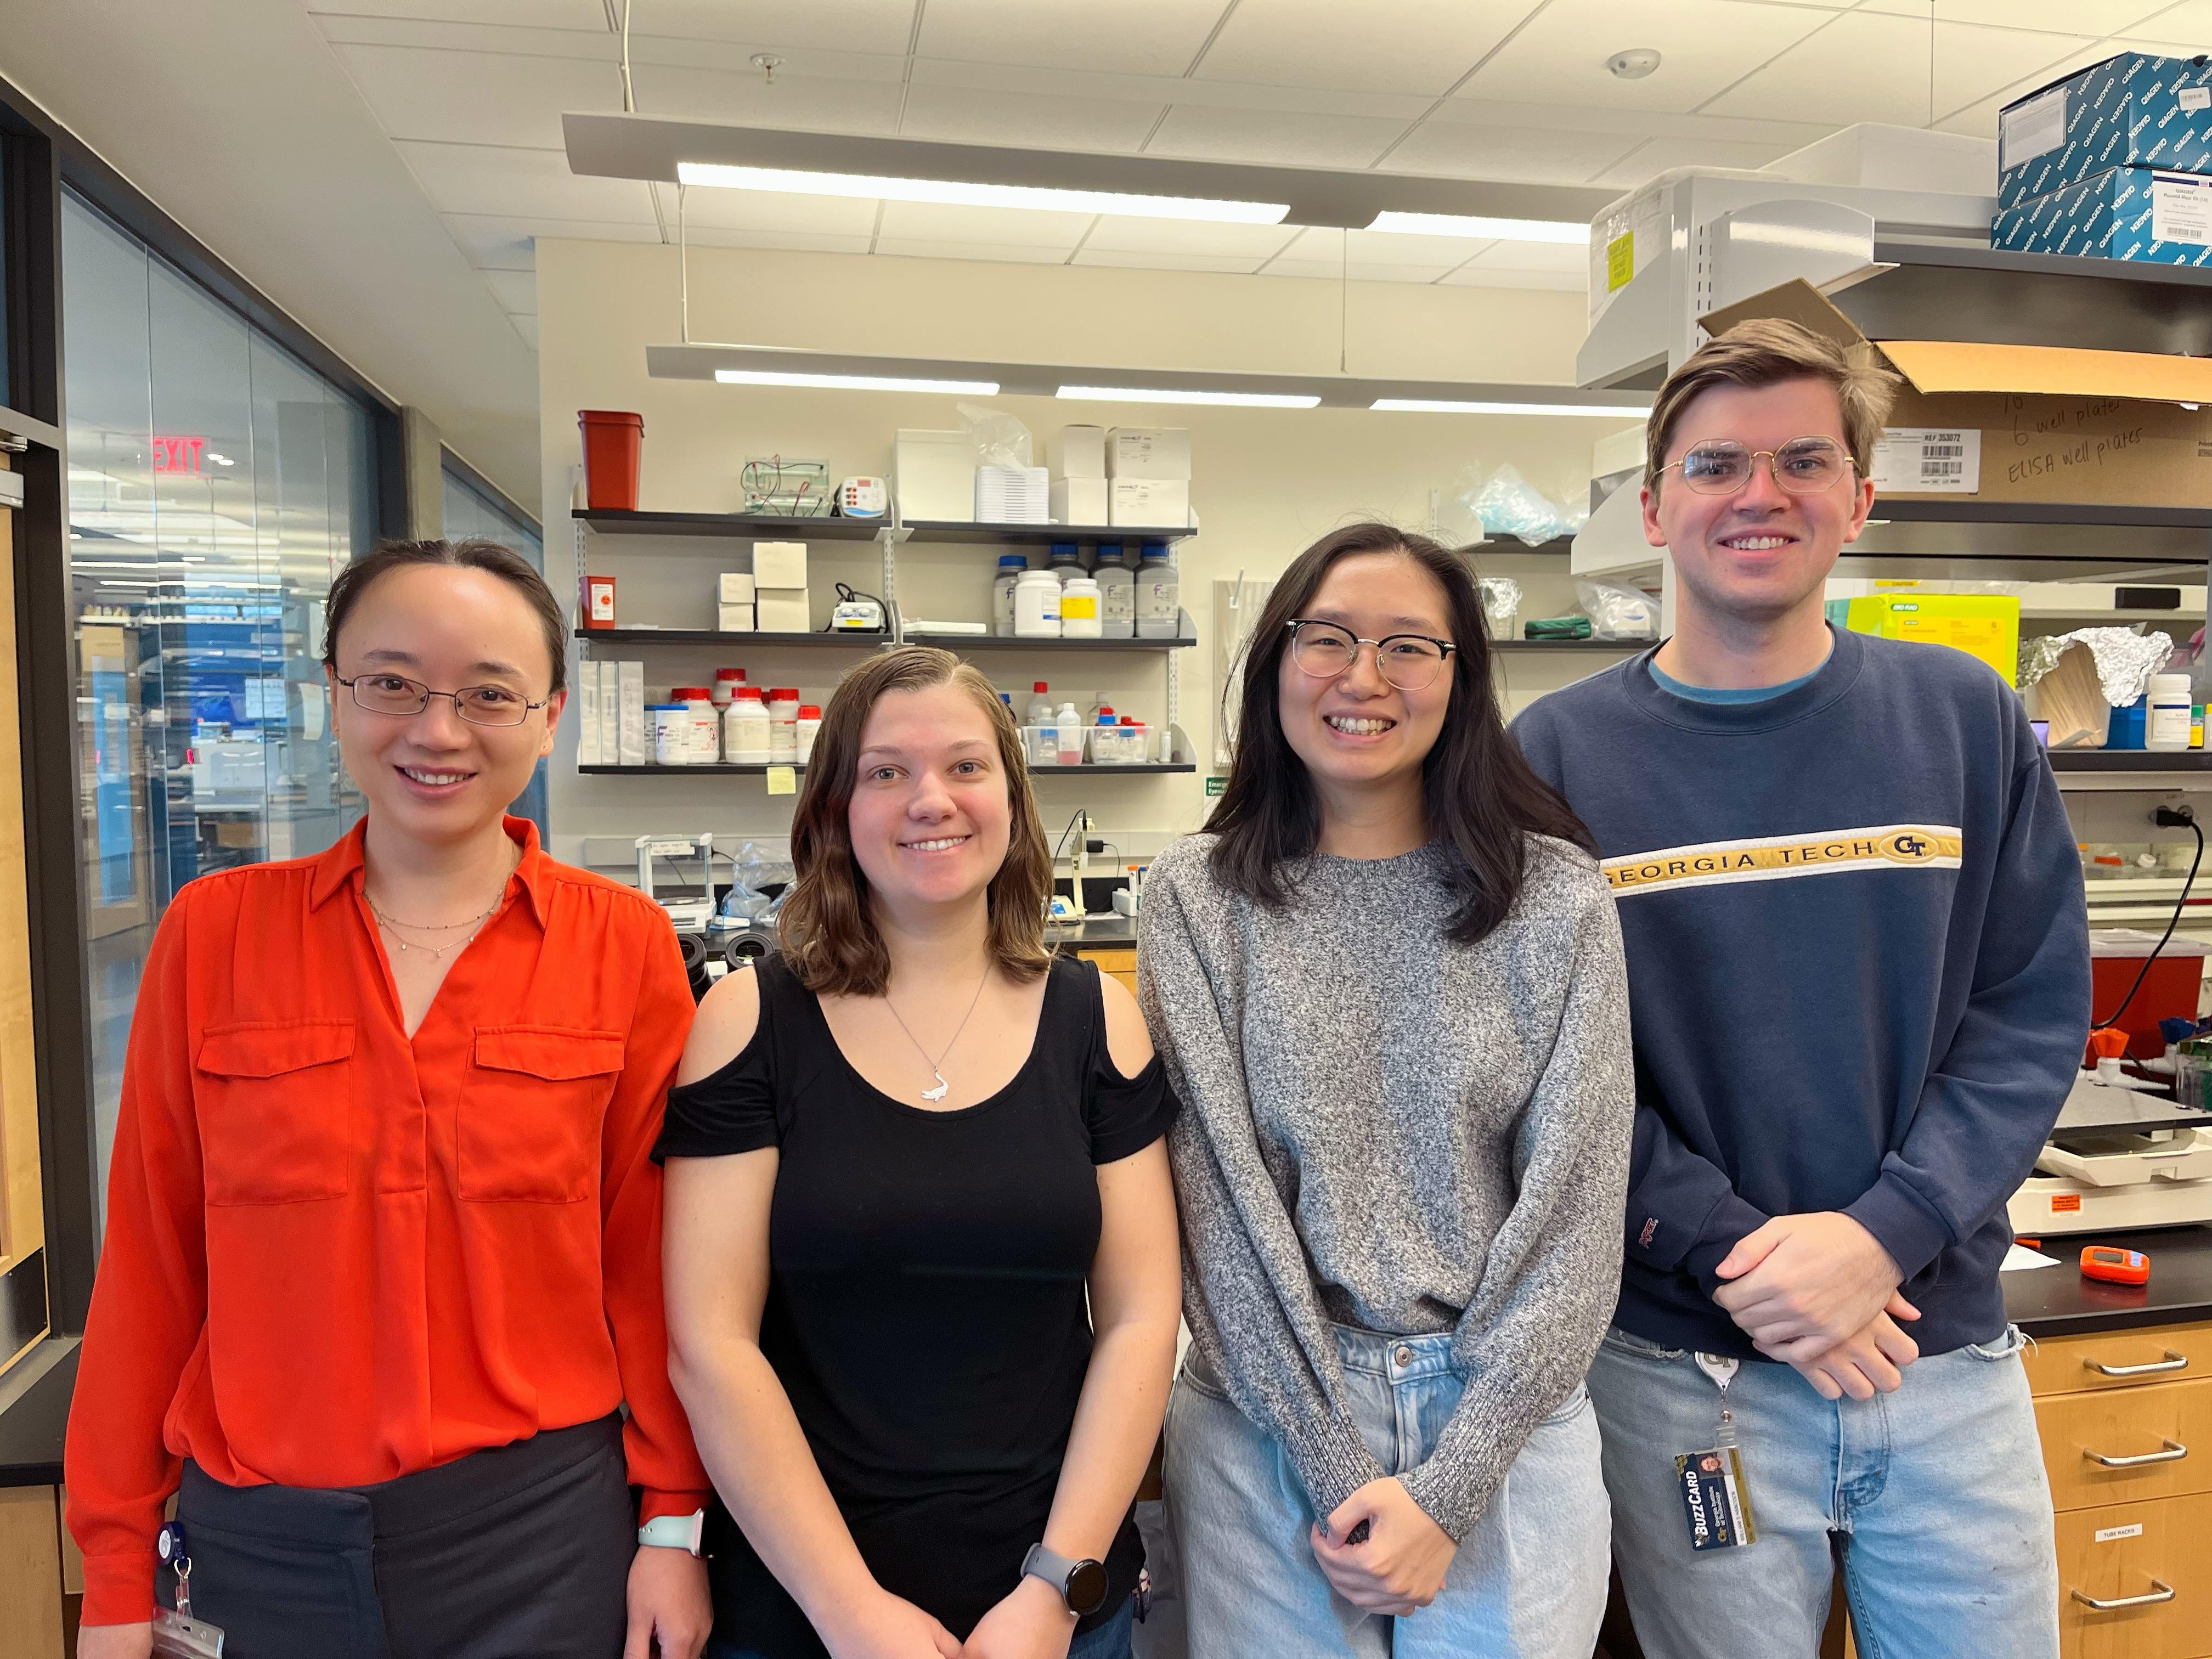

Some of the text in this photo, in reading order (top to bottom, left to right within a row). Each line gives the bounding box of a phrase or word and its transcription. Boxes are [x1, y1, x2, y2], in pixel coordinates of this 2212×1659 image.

[2122, 57, 2146, 84] QIAGEN
[2168, 71, 2190, 95] QIAGEN
[2196, 66, 2212, 86] QIAG
[2094, 78, 2114, 109] QIAGEN
[2141, 80, 2163, 105] QIAGEN
[2067, 102, 2087, 133] QIAGEN
[2110, 92, 2133, 123] QIAGEN
[2158, 104, 2179, 129] QIAGEN
[2084, 116, 2103, 148] QIAGEN
[2128, 114, 2151, 139] QIAGEN
[2174, 127, 2195, 153] QIAGEN
[2057, 140, 2076, 171] QIAGEN
[2100, 130, 2121, 162] QIAGEN
[2145, 138, 2167, 163] QIAGEN
[2033, 163, 2052, 193] QIAGEN
[2029, 195, 2049, 224] QIAGEN
[2068, 187, 2089, 217] QIAGEN
[2111, 185, 2135, 211] QIAGEN
[2005, 216, 2024, 245] QIAGEN
[2042, 210, 2062, 239] QIAGEN
[2083, 202, 2104, 233] QIAGEN
[2130, 208, 2153, 233] QIAGEN
[2057, 224, 2077, 255] QIAGEN
[2099, 219, 2123, 249] QIAGEN
[2014, 414, 2029, 446] 6
[2036, 410, 2065, 433] well
[154, 438, 202, 473] EXIT
[2008, 428, 2142, 483] ELISA well plates
[1779, 841, 1872, 863] TECH
